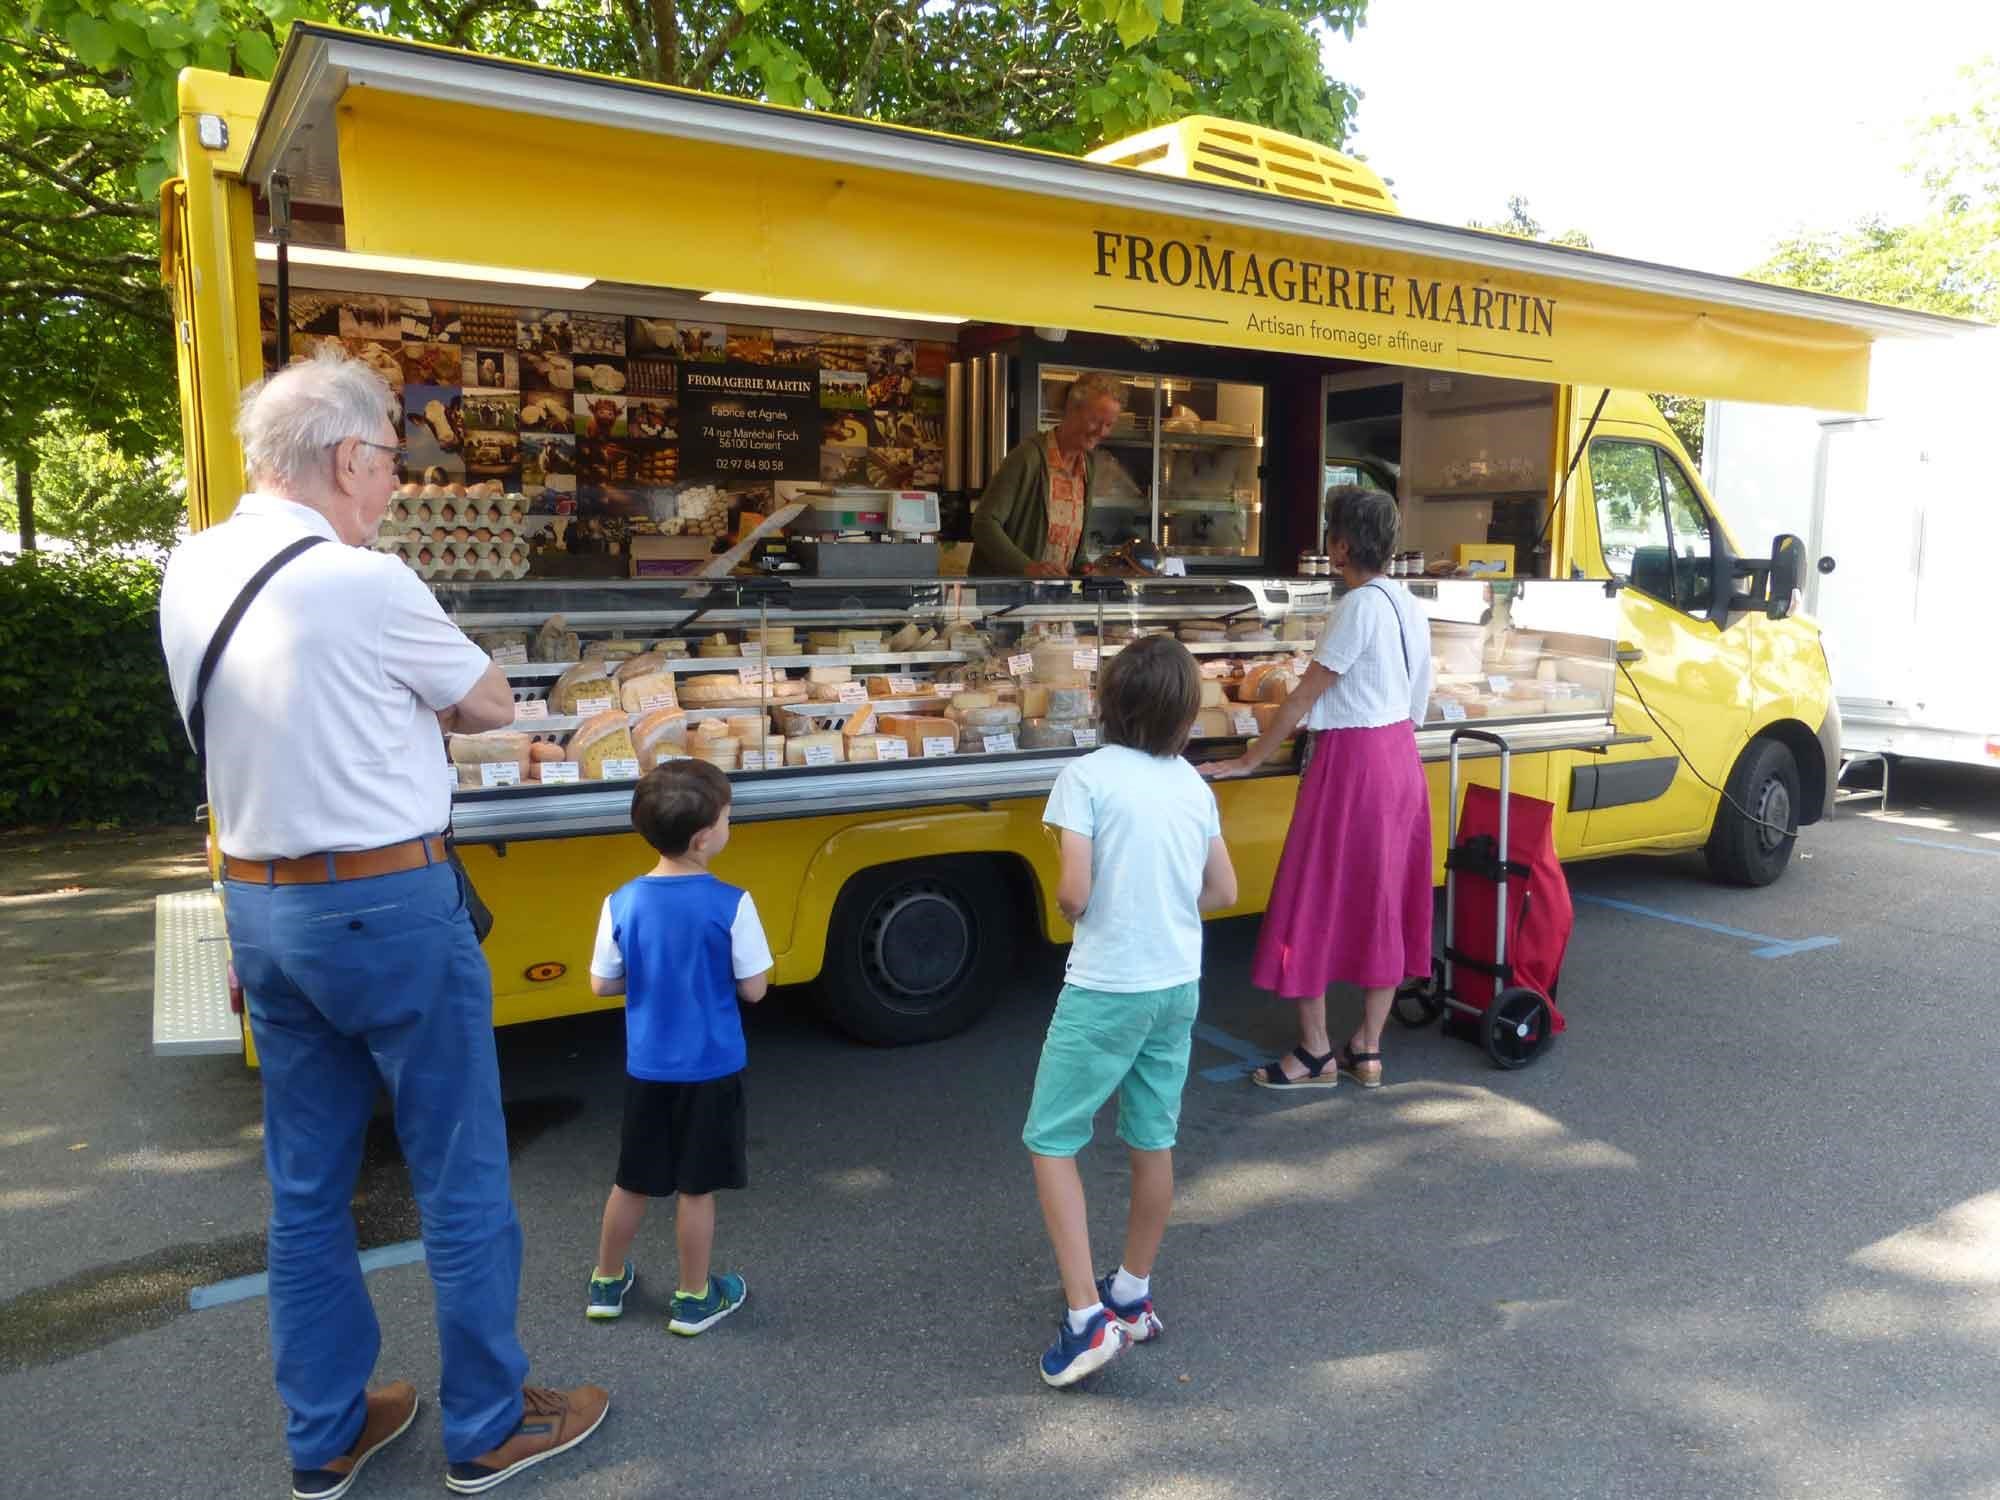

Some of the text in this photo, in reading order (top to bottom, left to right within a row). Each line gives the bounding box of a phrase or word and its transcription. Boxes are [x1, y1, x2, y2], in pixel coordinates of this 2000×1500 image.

[1093, 229, 1558, 338] FROMAGERIE MARTIN
[1246, 312, 1444, 353] Artisan fromager affineur
[687, 374, 812, 392] FROMAGERIE MARTIN
[711, 405, 745, 418] Fabrice
[747, 409, 757, 418] et
[703, 426, 799, 441] 74 rue Maréchal Foch
[719, 438, 781, 451] 56100 Lorient
[716, 458, 729, 470] 02
[730, 459, 743, 470] 97
[744, 459, 757, 470] 84
